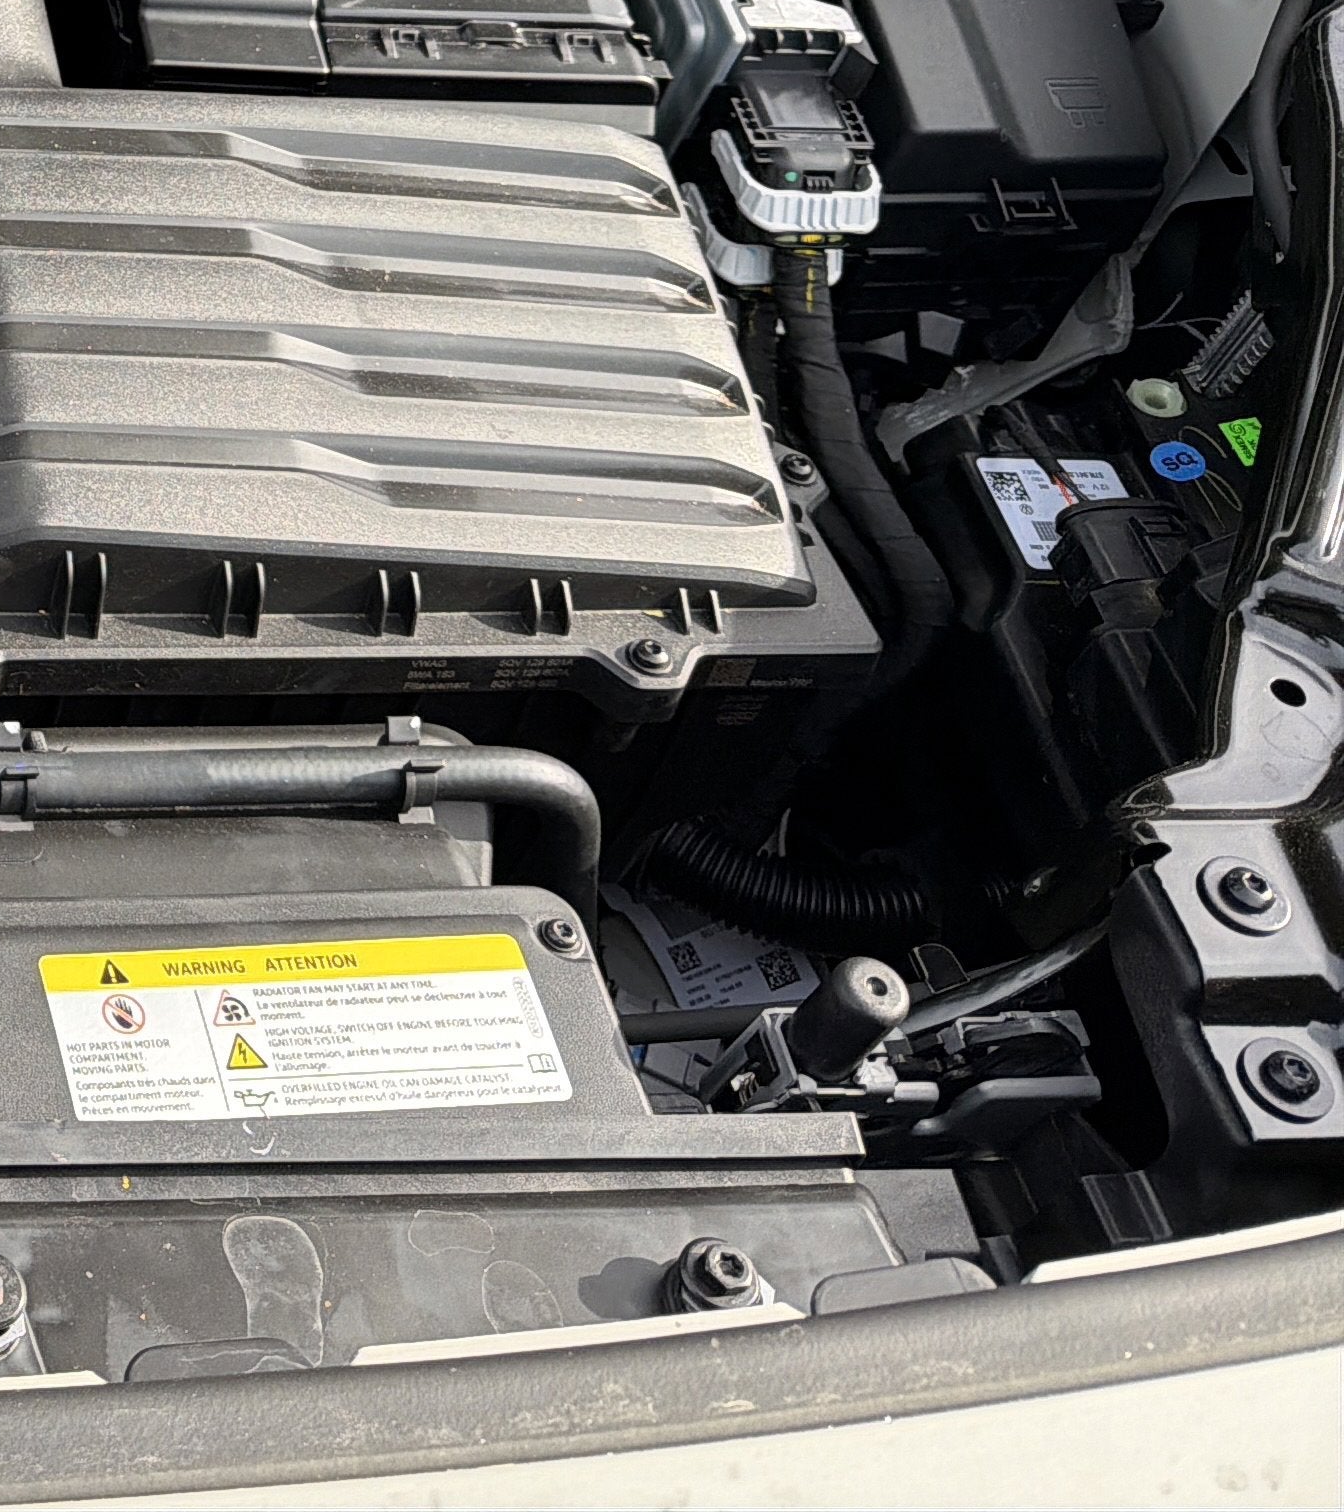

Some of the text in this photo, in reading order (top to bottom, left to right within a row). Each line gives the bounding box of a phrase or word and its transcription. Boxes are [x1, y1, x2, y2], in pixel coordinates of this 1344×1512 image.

[1160, 451, 1199, 472] SQ
[161, 953, 359, 977] WARNING ATTENTION
[253, 987, 302, 998] RADIATOR
[303, 986, 323, 995] FAN
[324, 985, 345, 995] MAY
[346, 983, 375, 993] START
[377, 983, 389, 991] AT
[390, 982, 410, 990] ANY
[326, 998, 339, 1007] de
[265, 1027, 290, 1037] HIGH
[338, 1023, 376, 1034] SWITCH
[377, 1022, 395, 1032] OFF
[398, 1020, 434, 1031] ENGINE
[435, 1019, 472, 1029] BEFORE
[66, 1039, 172, 1053] HOT PARTS IN MOTOR
[268, 1038, 313, 1048] IGNITION
[72, 1065, 113, 1076] MOVING
[282, 1082, 342, 1094] OVERFILLED
[343, 1080, 380, 1091] ENGINE
[400, 1077, 421, 1087] CAN
[422, 1075, 464, 1087] DAMAGE
